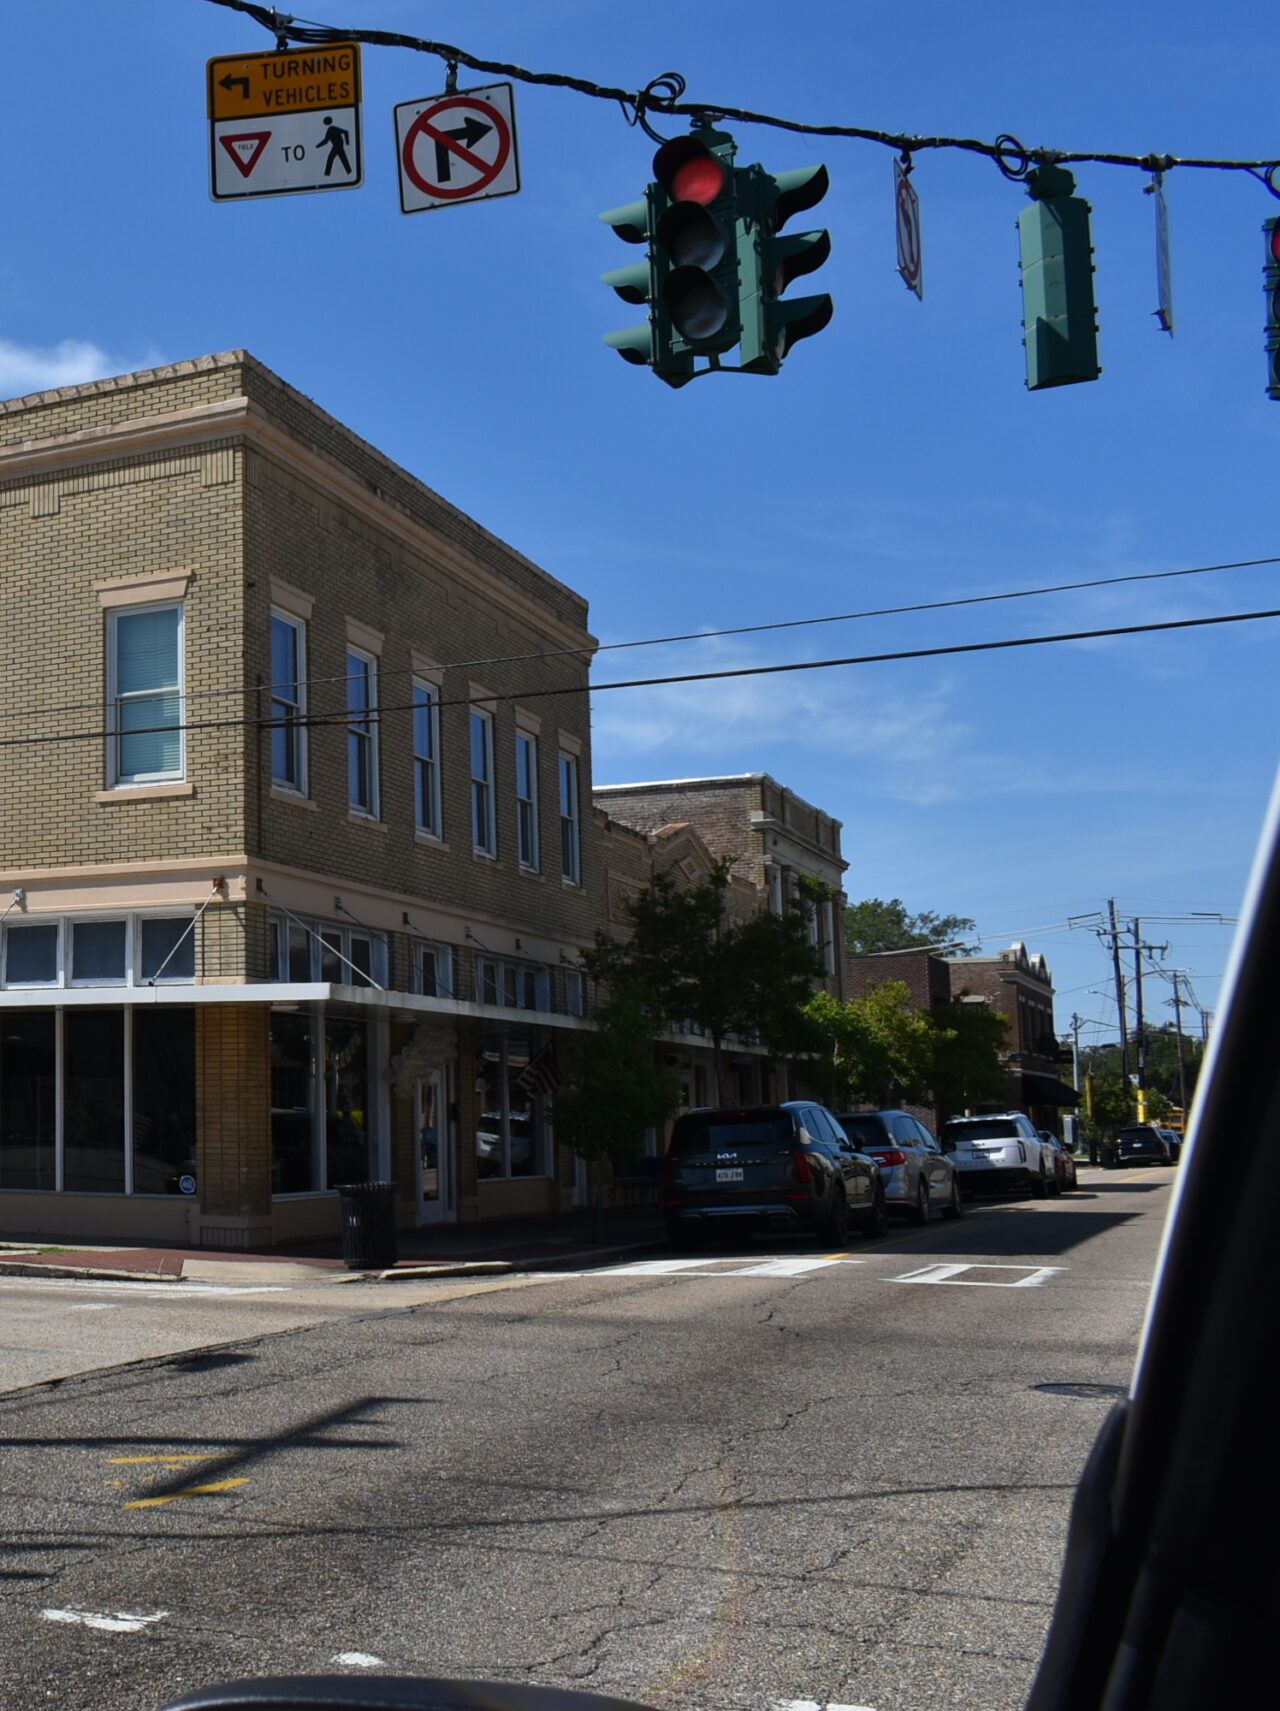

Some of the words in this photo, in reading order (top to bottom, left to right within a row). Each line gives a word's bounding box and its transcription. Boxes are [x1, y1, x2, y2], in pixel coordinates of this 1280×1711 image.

[261, 54, 351, 80] TURNING
[262, 82, 350, 107] VEHICLES
[238, 143, 254, 151] YIELD
[281, 144, 305, 163] TO
